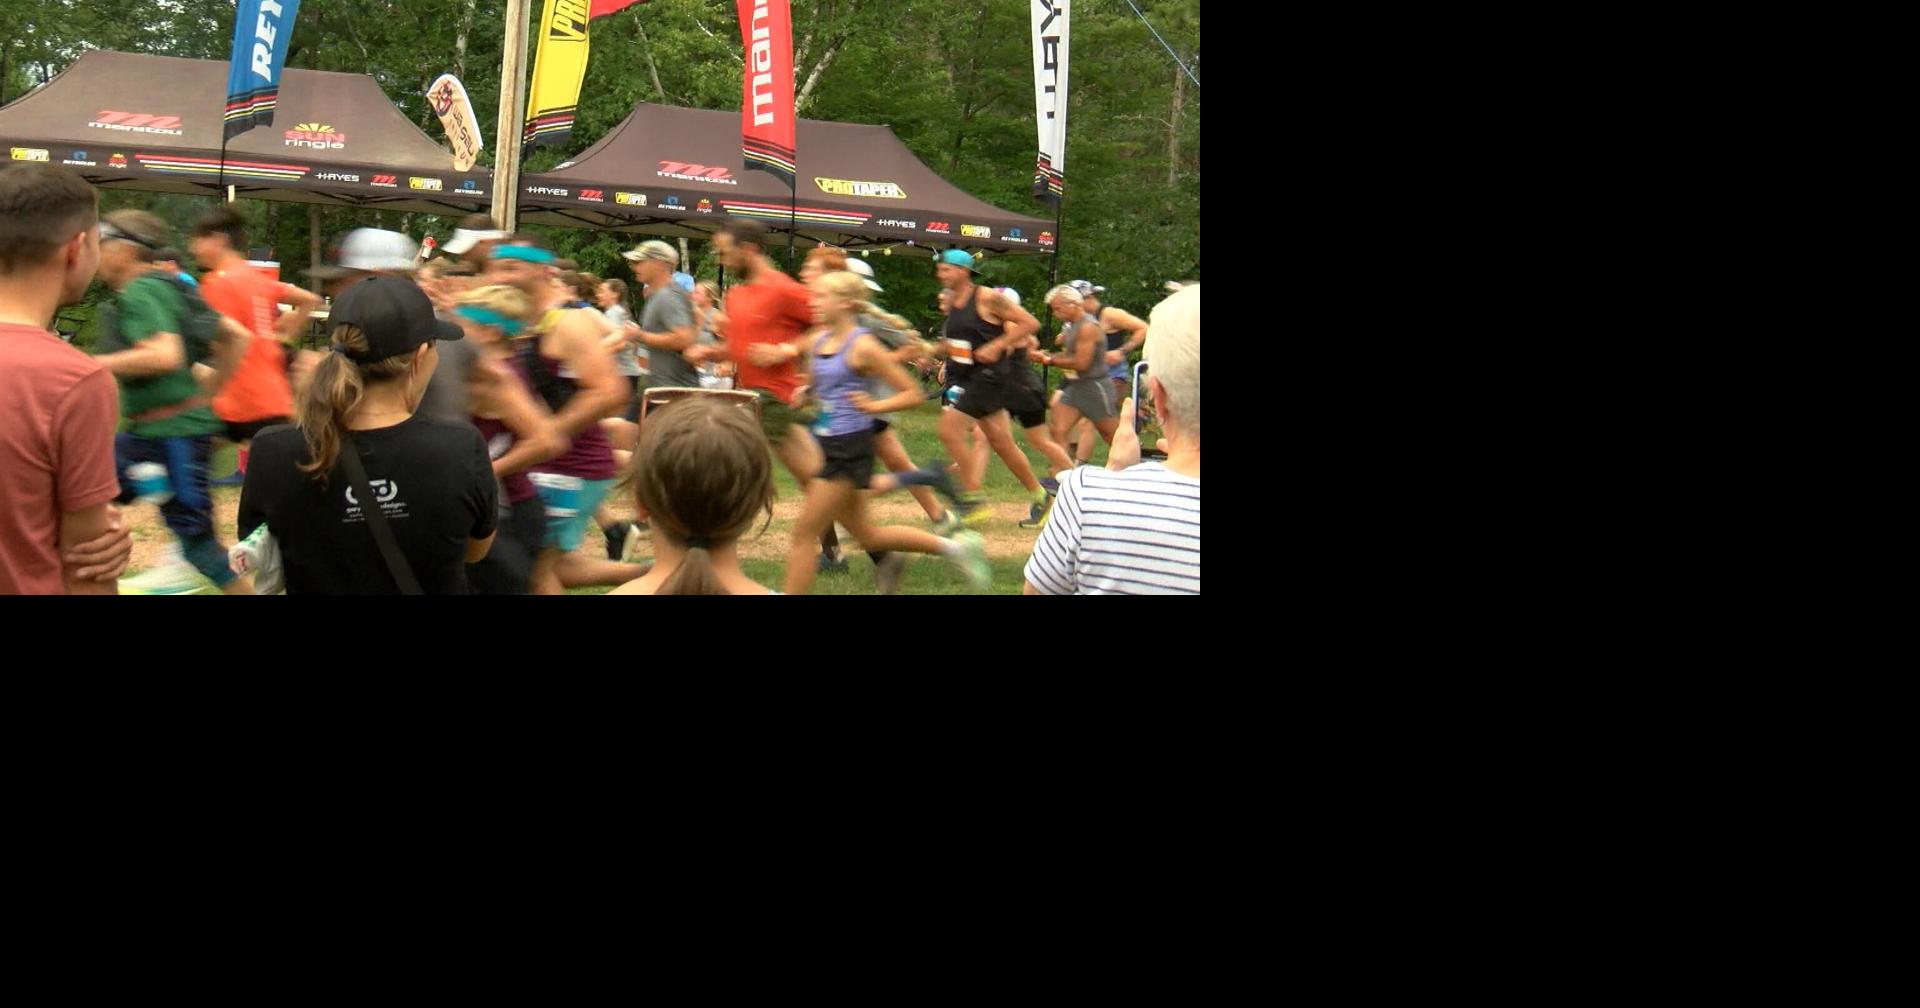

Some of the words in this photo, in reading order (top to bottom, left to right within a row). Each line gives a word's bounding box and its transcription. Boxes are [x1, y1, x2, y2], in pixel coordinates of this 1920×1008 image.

[284, 130, 345, 142] SUN
[315, 172, 360, 183] HAYES
[525, 186, 569, 197] HAYES
[876, 219, 917, 229] HAYES
